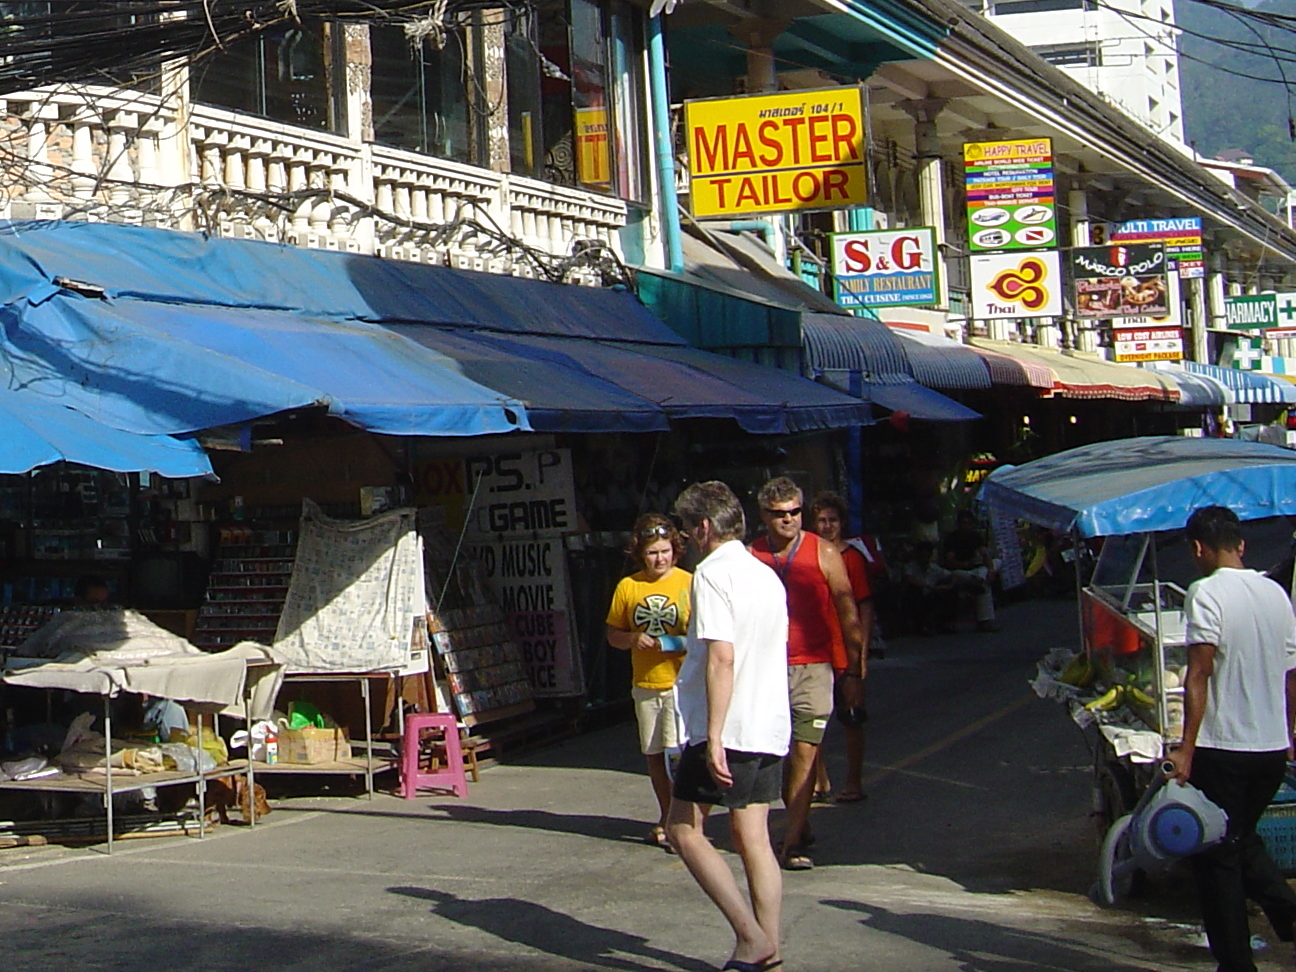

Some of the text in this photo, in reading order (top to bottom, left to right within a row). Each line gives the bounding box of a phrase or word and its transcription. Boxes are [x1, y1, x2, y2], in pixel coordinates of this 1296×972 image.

[694, 114, 859, 174] MASTER
[985, 143, 1050, 157] HAPPY TRAVEL
[709, 169, 850, 209] TAILOR
[1118, 219, 1200, 234] ULTI TRAVEL
[1075, 252, 1163, 277] MARCO POLO
[839, 275, 932, 294] FAMILY RESTAURANT
[865, 293, 901, 303] CUISINE
[987, 303, 1016, 315] Thai
[489, 499, 568, 533] GAME
[502, 543, 553, 578] MUSIC
[502, 585, 554, 613] MOVIE
[515, 615, 555, 636] CUBE
[523, 640, 557, 663] BOY
